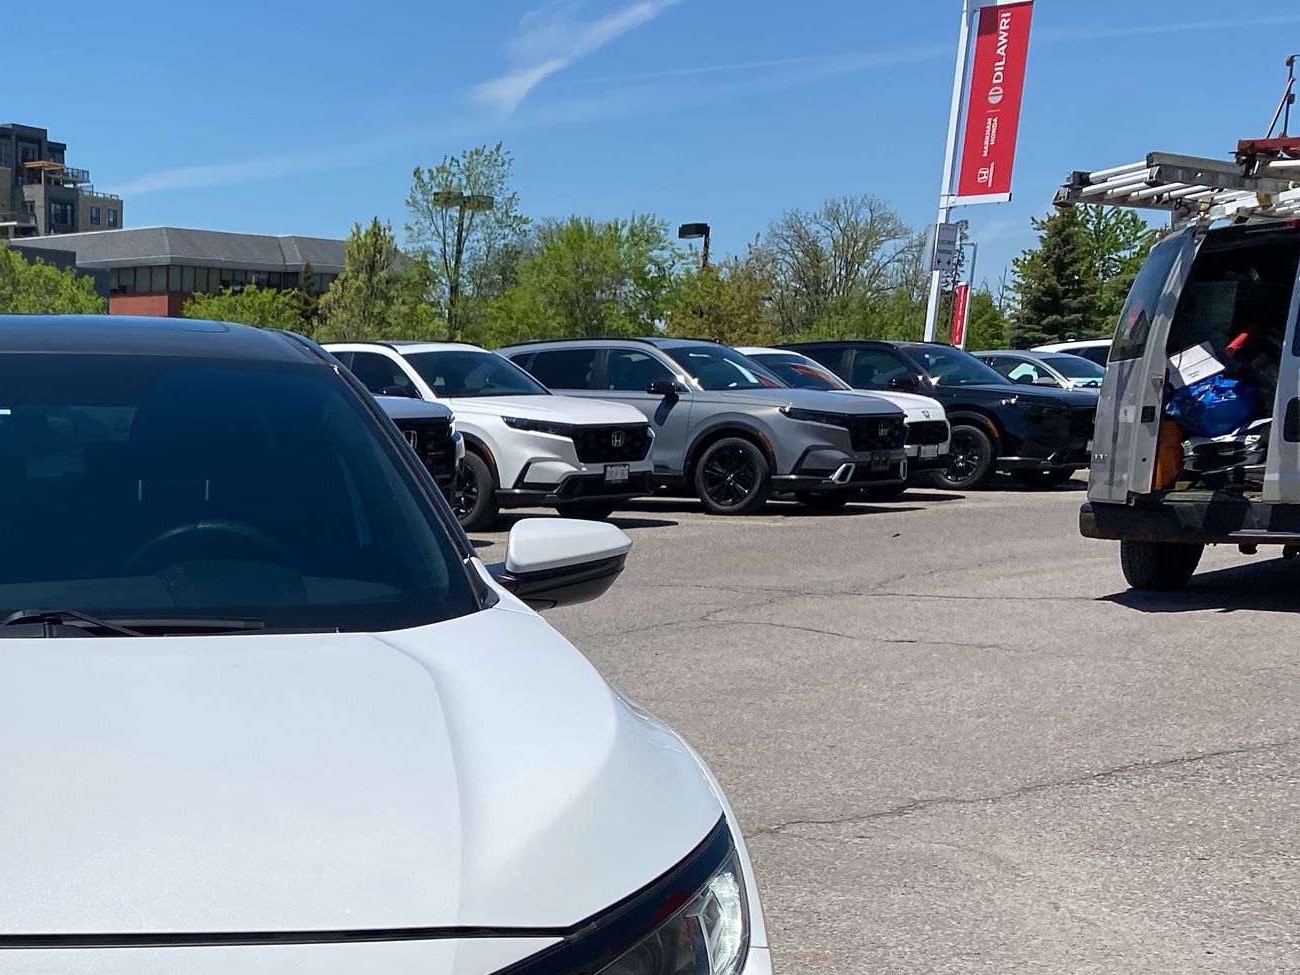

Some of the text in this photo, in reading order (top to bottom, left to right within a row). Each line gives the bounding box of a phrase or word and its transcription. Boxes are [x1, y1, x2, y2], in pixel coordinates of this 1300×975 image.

[992, 12, 1012, 84] DILAWRI
[982, 117, 993, 157] MARKHAM
[989, 116, 999, 145] HONDA
